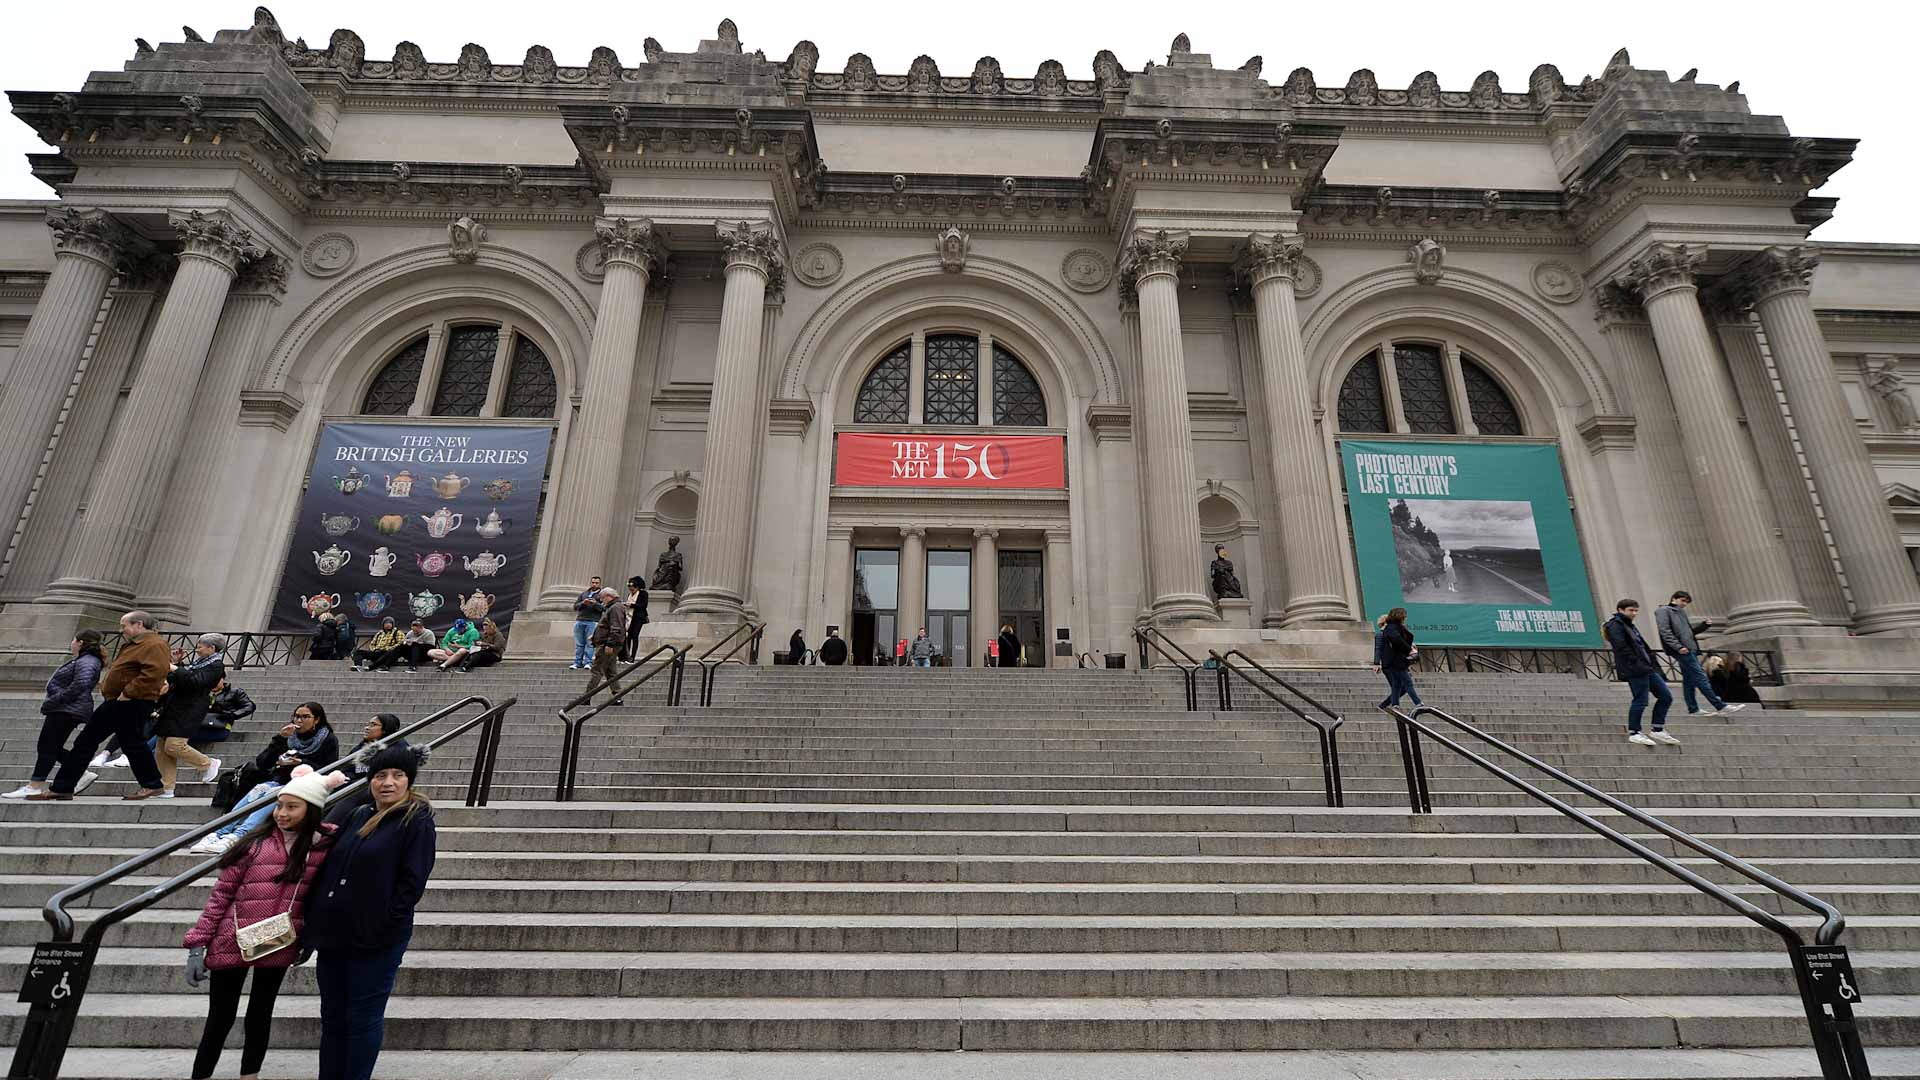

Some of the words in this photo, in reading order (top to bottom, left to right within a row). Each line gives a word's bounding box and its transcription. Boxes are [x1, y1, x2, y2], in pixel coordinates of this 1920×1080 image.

[400, 435, 433, 447] THE
[434, 436, 471, 448] NEW
[892, 441, 929, 459] THE
[335, 446, 415, 462] BRITISH
[418, 448, 529, 465] GALLERIES
[891, 460, 930, 479] MET
[931, 442, 1010, 480] 150
[1355, 453, 1458, 476] PHOTOGRAPHY'S
[1359, 474, 1390, 494] LAST
[1393, 475, 1450, 496] CENTURY
[1497, 609, 1512, 620] THE
[1512, 610, 1527, 621] ANN
[1568, 610, 1583, 621] AND
[1496, 620, 1525, 632] THOMAS
[1534, 621, 1546, 632] LEE
[1546, 621, 1586, 632] COLLECTION
